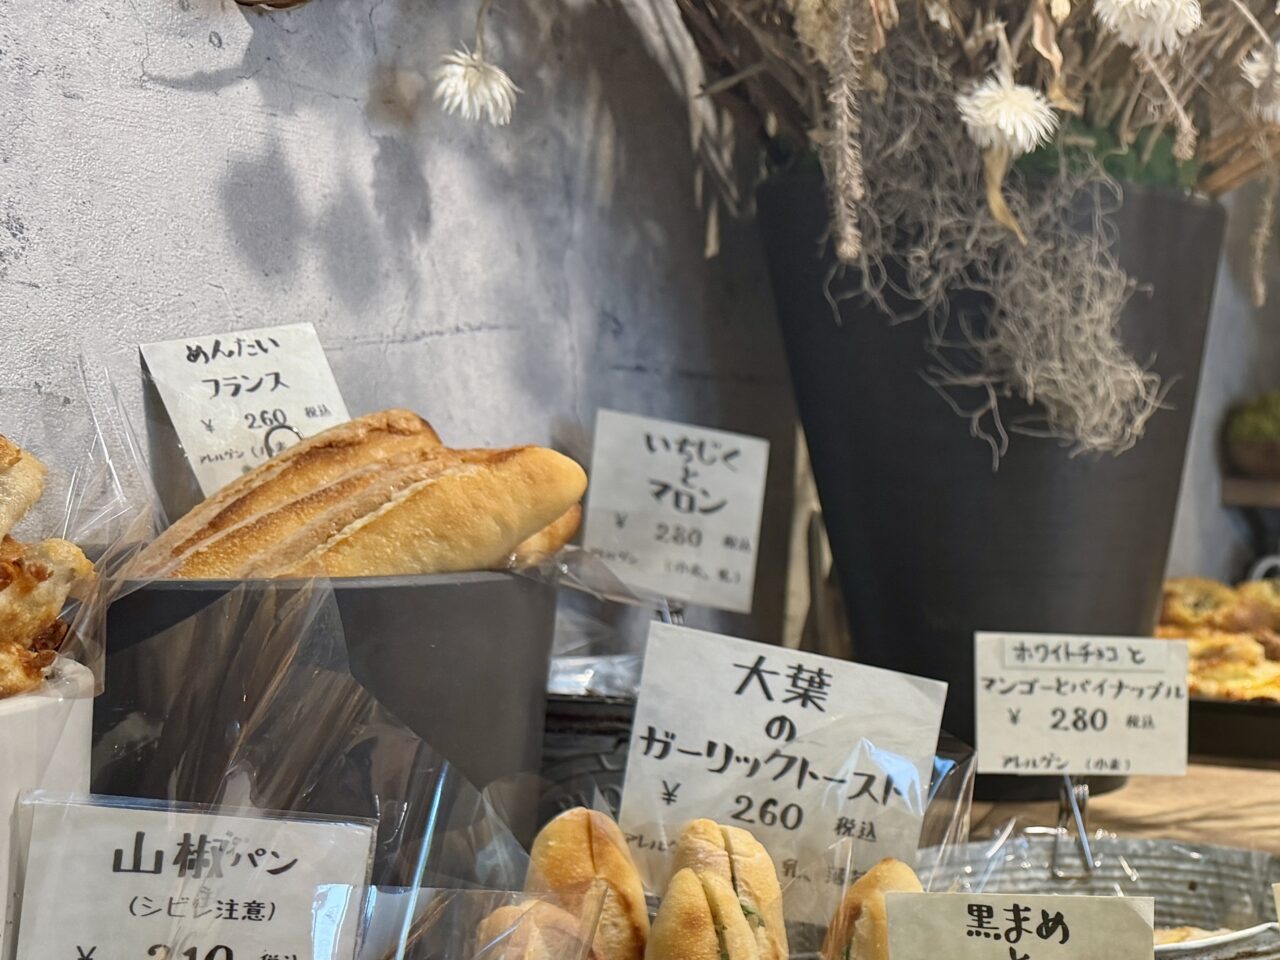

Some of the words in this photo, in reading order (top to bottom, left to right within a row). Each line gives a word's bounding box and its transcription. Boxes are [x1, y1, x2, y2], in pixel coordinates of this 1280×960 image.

[186, 338, 280, 364] めんたい
[202, 371, 290, 397] フランス
[201, 418, 215, 433] ¥
[244, 408, 287, 430] 260
[304, 404, 332, 419] 税込
[644, 432, 741, 472] いちじく
[681, 466, 699, 488] と
[647, 478, 728, 515] マロン
[614, 512, 627, 529] ¥
[654, 522, 703, 549] 280
[733, 655, 832, 713] 大葉
[764, 714, 797, 743] の
[1007, 707, 1021, 726] ¥
[1050, 707, 1109, 732] 280
[1125, 713, 1155, 730] 税込
[639, 725, 903, 806] ガーリックトースト
[1002, 752, 1069, 769] アレルゲン
[661, 779, 682, 805] ¥
[731, 794, 803, 832] 260
[834, 815, 878, 842] 税込
[112, 830, 298, 879] 山椒パン
[966, 903, 1070, 945] 黒まめ
